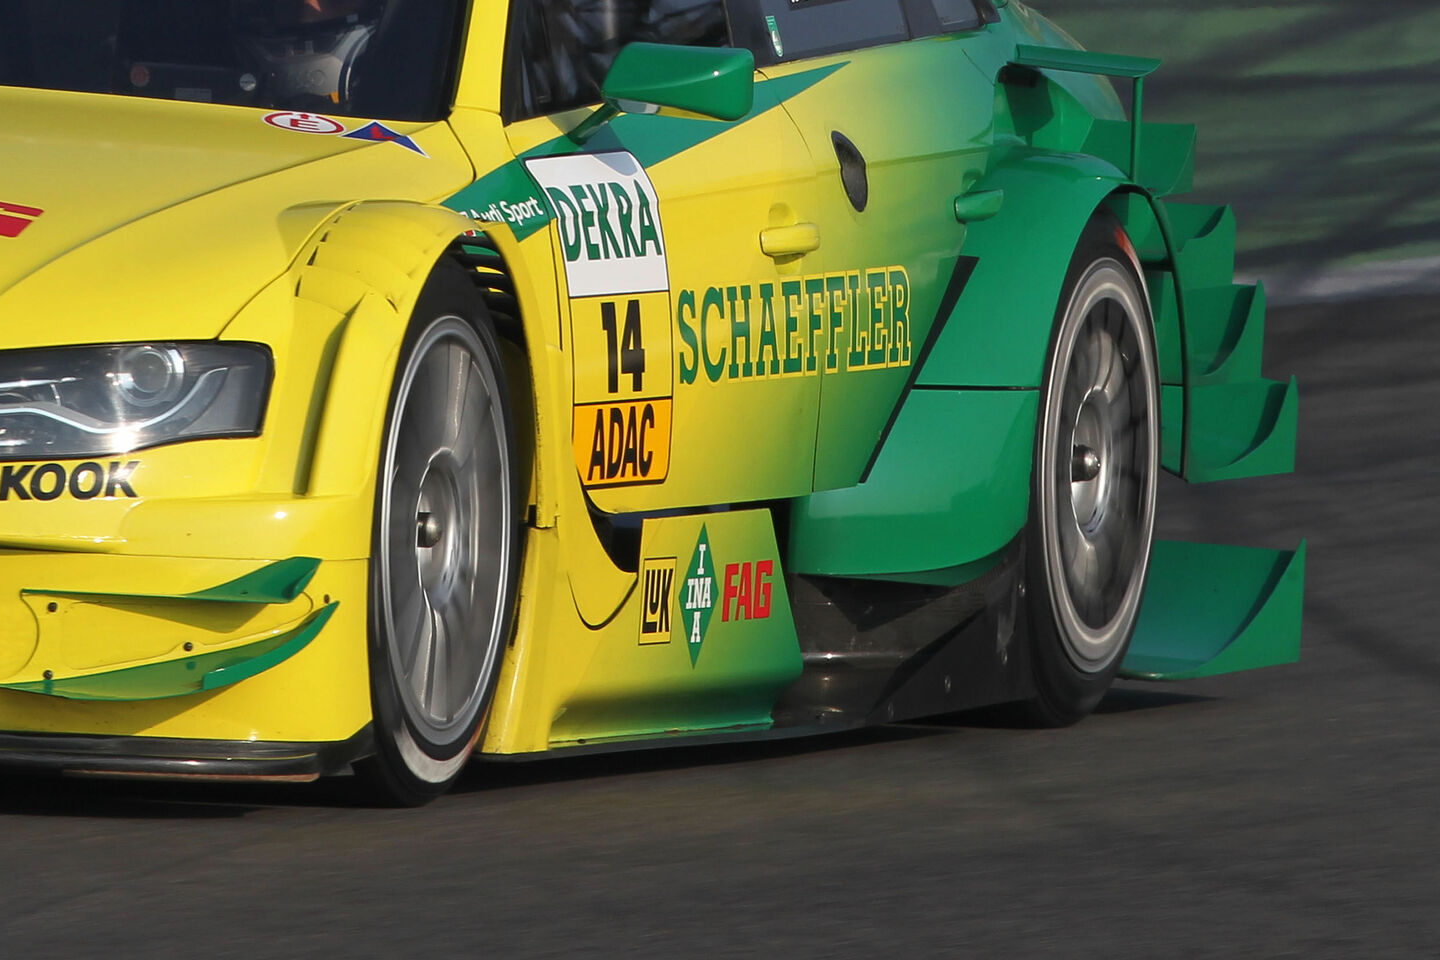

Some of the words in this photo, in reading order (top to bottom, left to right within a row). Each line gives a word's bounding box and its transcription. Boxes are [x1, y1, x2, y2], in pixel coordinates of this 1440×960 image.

[498, 196, 545, 227] Sport
[546, 179, 663, 263] DEKRA
[600, 298, 646, 394] 14
[677, 265, 912, 385] SCHAEFFLER
[587, 402, 656, 482] ADAC
[721, 559, 774, 622] FAG
